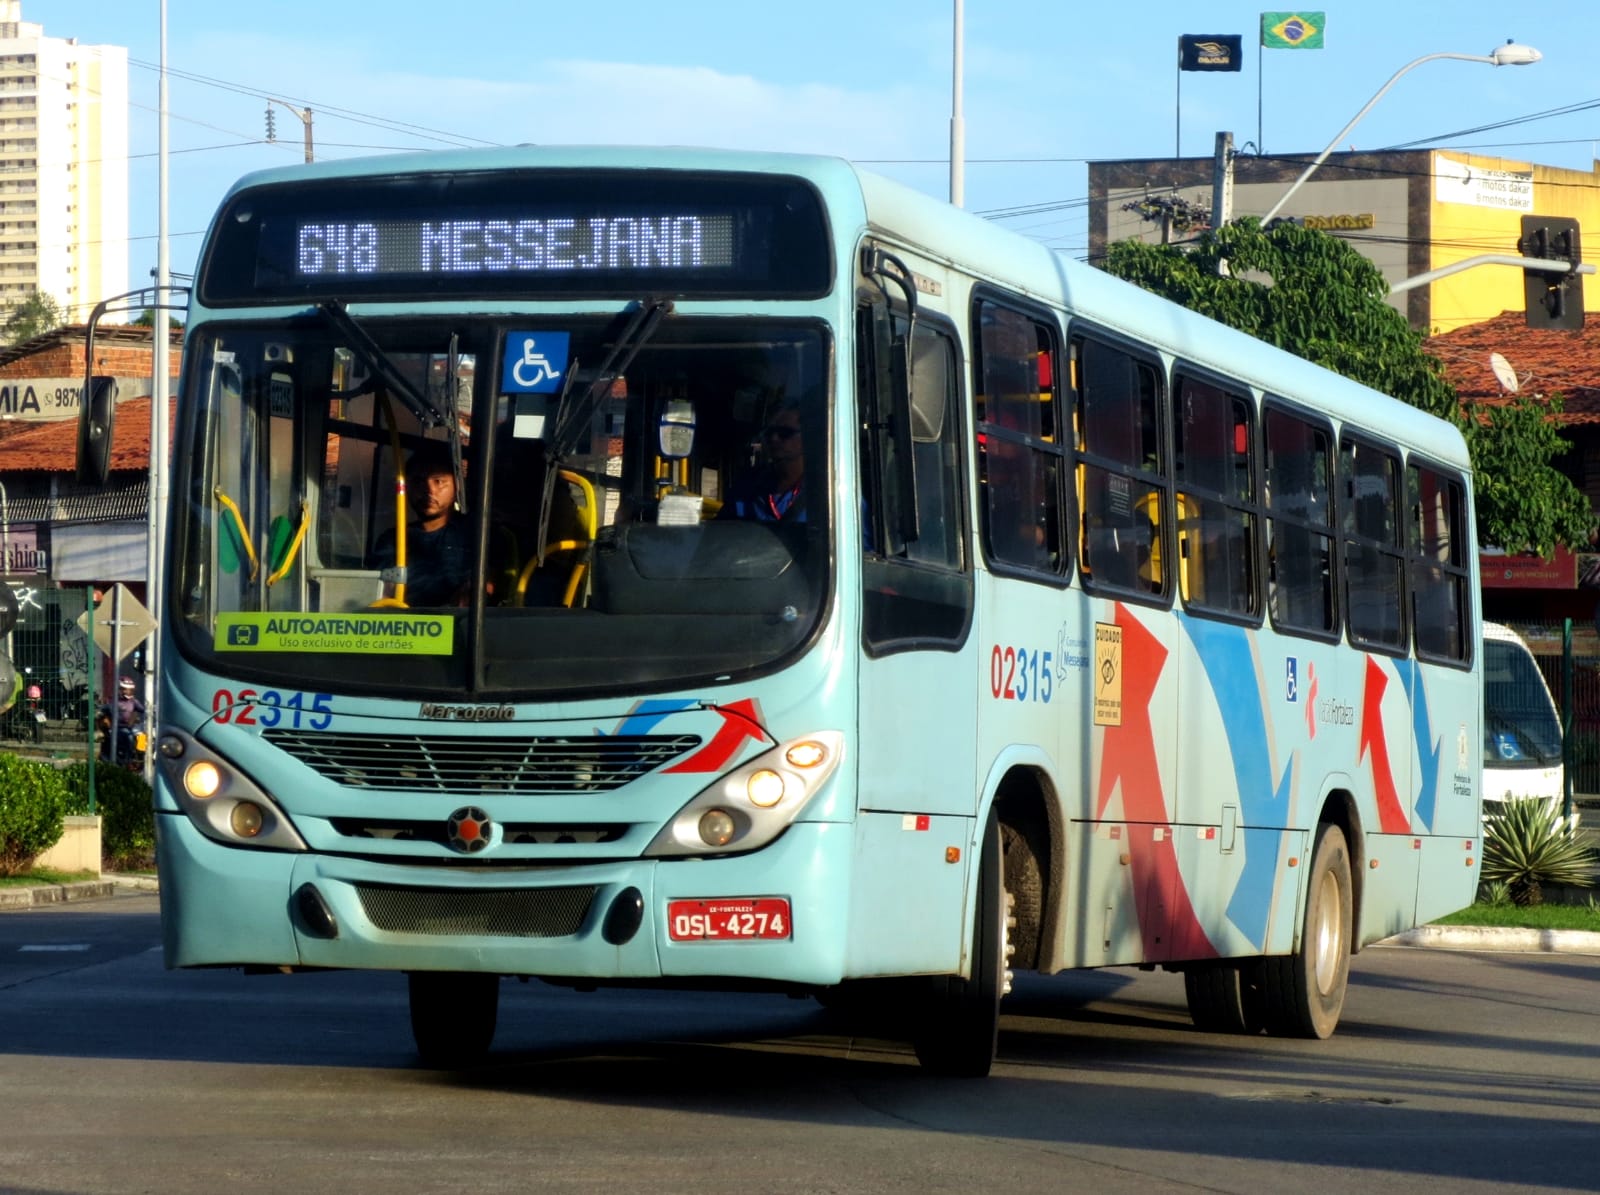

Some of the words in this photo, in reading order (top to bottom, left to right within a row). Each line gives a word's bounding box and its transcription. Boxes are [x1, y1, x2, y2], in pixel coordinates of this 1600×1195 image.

[1304, 214, 1375, 229] DAKAR
[421, 215, 704, 272] MESSEJANA
[0, 543, 47, 570] shion
[265, 618, 442, 637] AUTOATENDIMENTO
[279, 636, 299, 648] Uso
[302, 638, 353, 648] exclusivo
[356, 637, 370, 649] de
[372, 639, 414, 650] cartões
[991, 644, 1052, 703] 02315
[212, 689, 333, 730] 02315
[420, 702, 516, 720] Marcopolo
